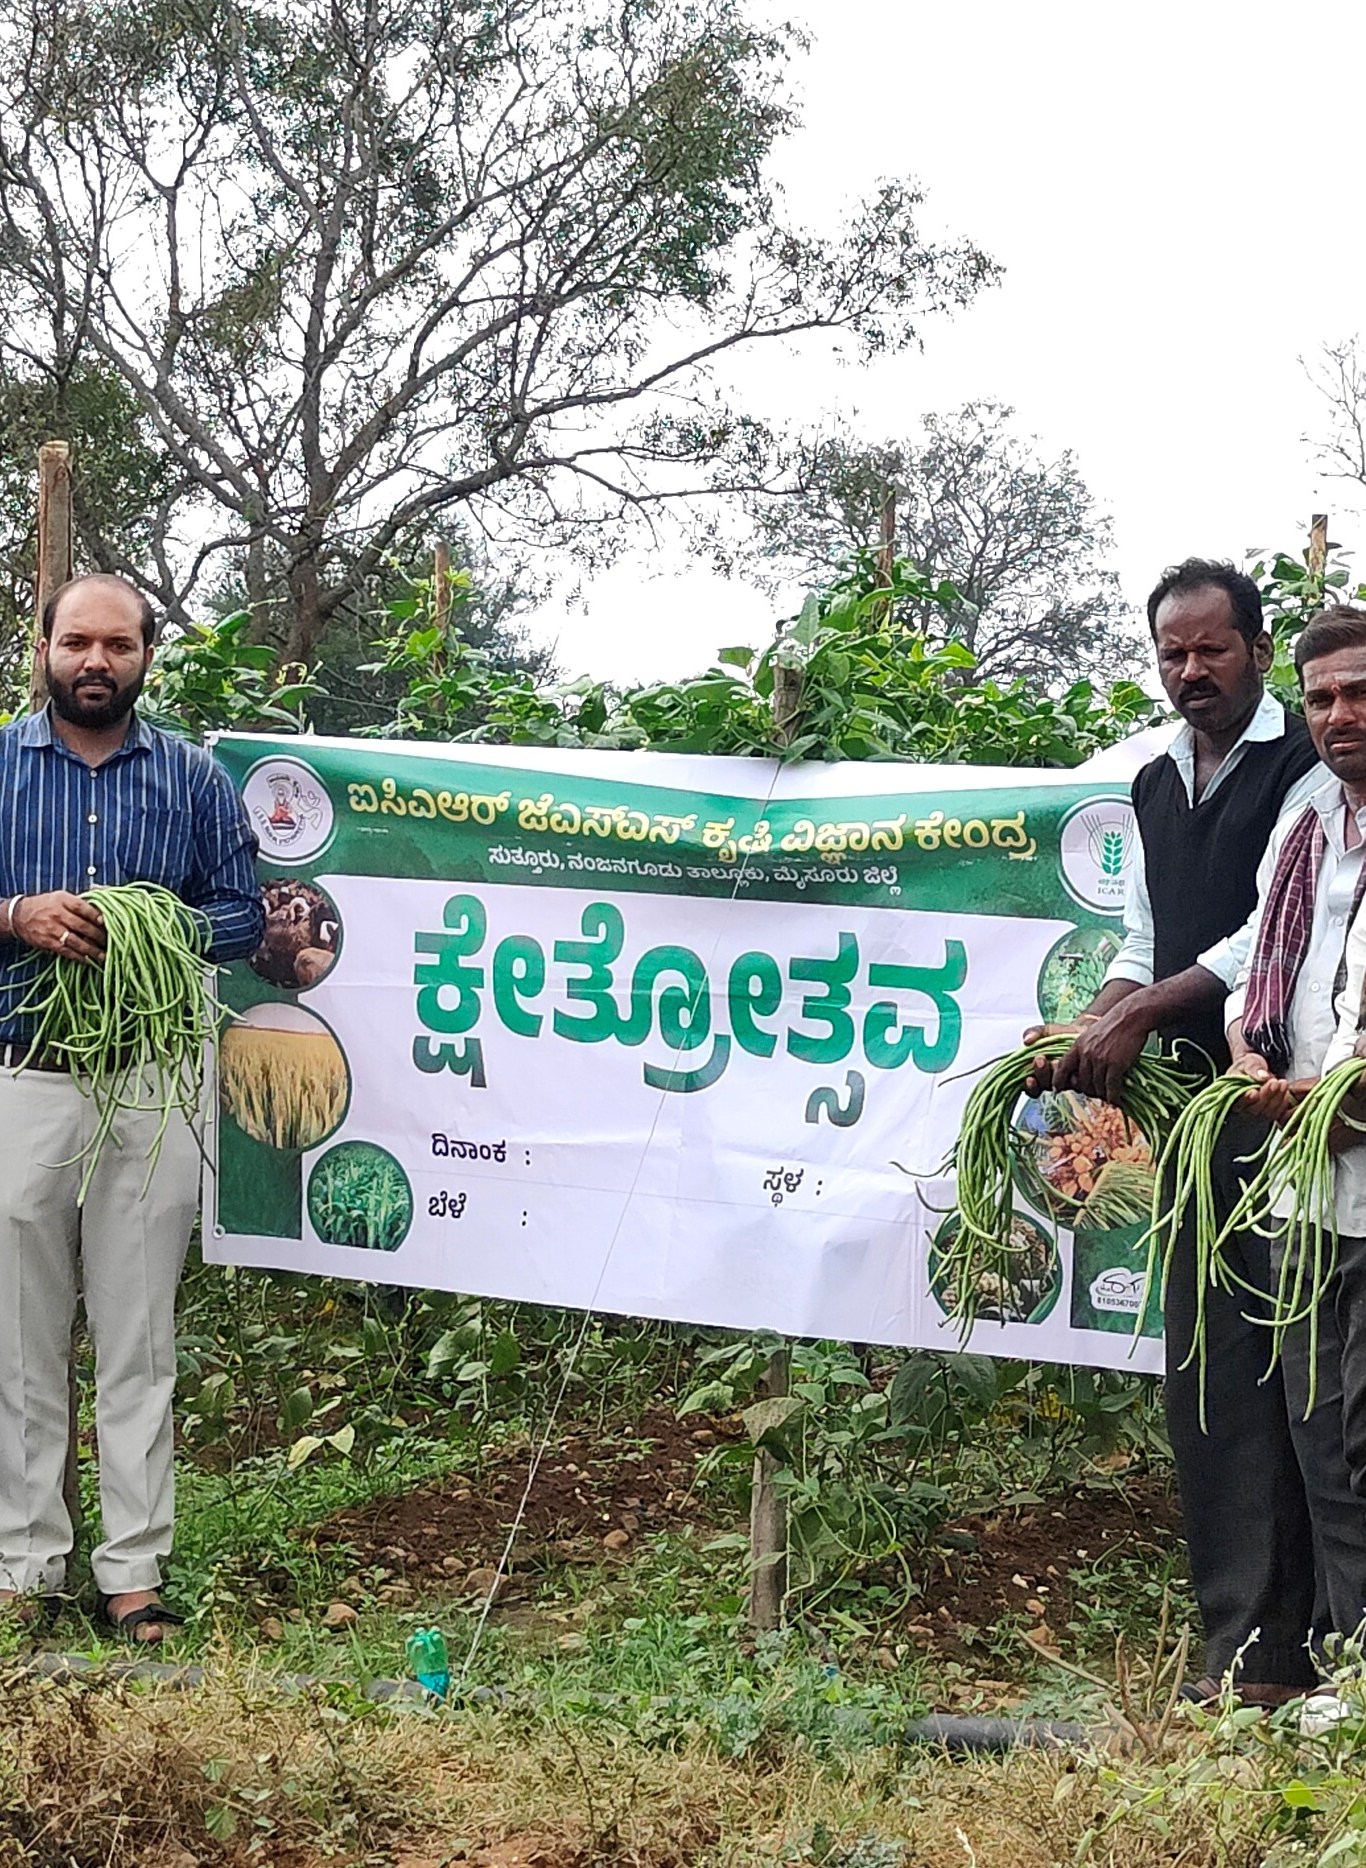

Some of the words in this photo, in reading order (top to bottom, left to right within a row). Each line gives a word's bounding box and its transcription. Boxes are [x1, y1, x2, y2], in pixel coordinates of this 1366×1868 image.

[347, 778, 512, 825] ಐಸಿಎಆರ್
[702, 817, 770, 863] ಕೃಷಿ
[780, 813, 907, 865] ವಿಜ್ಞಾನ
[914, 810, 1037, 860] ಕೇಂದ್ರ
[488, 846, 565, 874] ಸುತ್ತೂರು,
[568, 852, 683, 878] ನಂಜನಗೂಡು
[773, 866, 858, 890] ಮೈಸೂರು
[863, 866, 902, 895] ಜಿಲ್ಲೆ
[1098, 887, 1125, 895] ICAR
[412, 894, 968, 1128] ಕ್ಷೇತ್ರೋತ್ಸವ
[431, 1133, 507, 1163] ದಿನಾಂಕ
[428, 1191, 467, 1218] ಬೆಳೆ
[762, 1166, 804, 1208] ಸ್ಥಳ
[1097, 1297, 1142, 1308] 810536700
